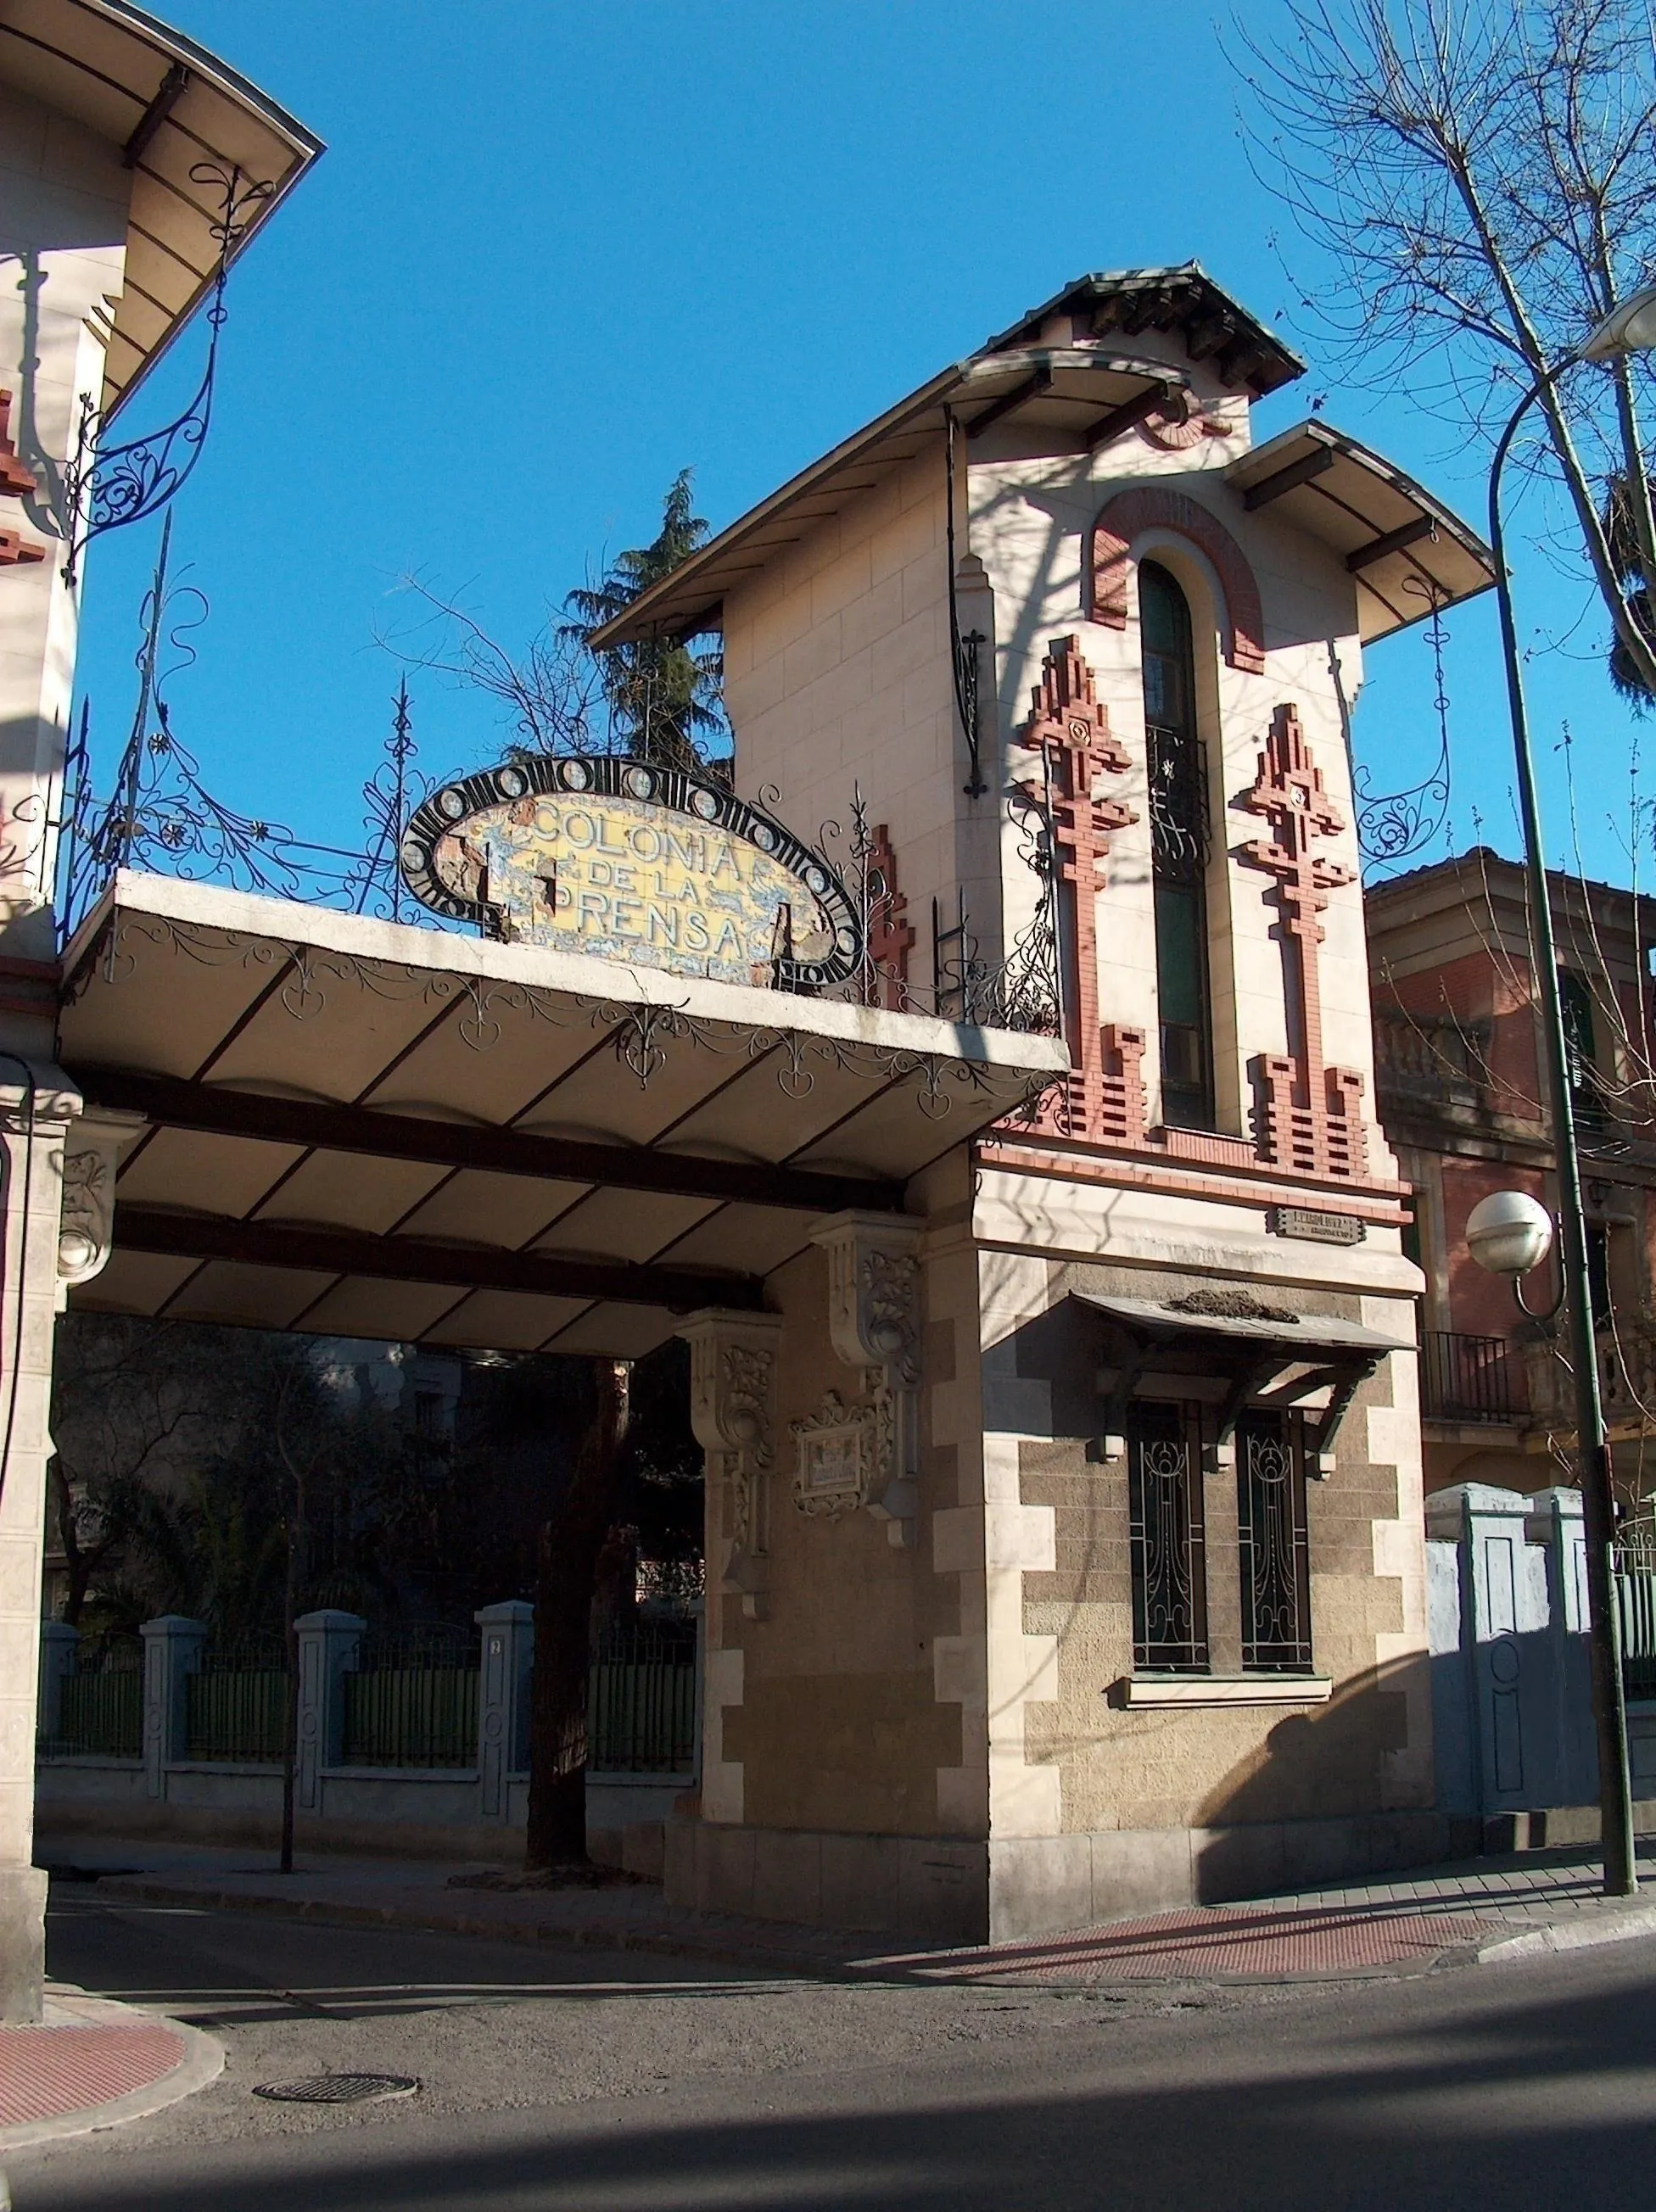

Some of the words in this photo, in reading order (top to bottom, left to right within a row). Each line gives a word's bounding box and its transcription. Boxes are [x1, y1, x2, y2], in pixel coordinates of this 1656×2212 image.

[533, 802, 742, 880] COLONIA
[589, 859, 636, 891] DE
[654, 871, 698, 904] LA
[554, 887, 742, 959] PRENSA
